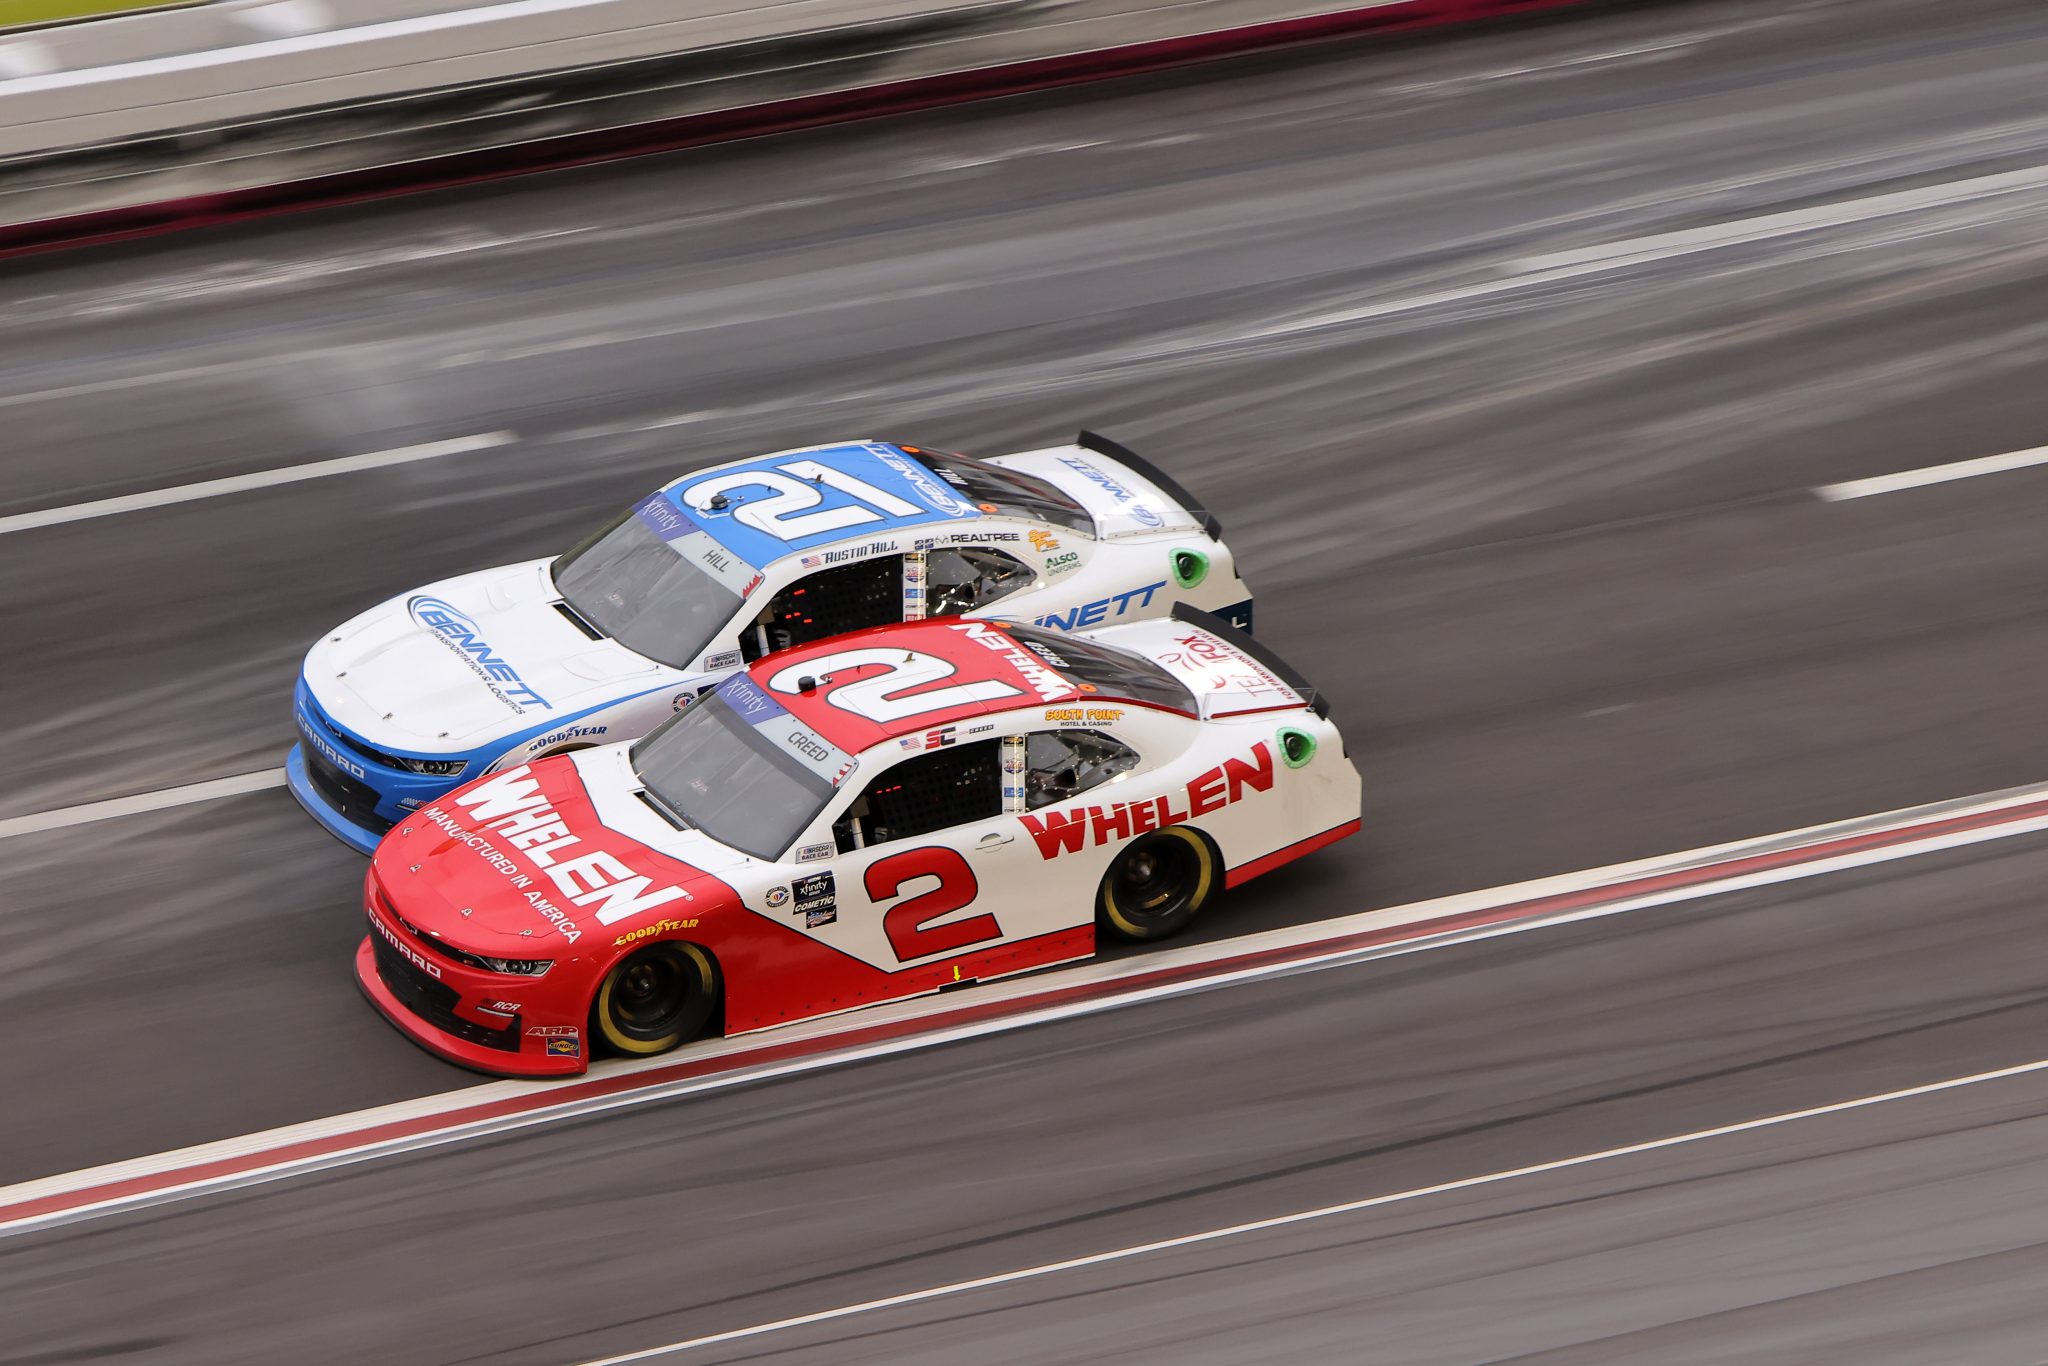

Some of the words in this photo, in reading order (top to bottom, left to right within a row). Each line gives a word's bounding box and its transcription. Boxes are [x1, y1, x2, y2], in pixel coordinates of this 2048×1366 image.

[933, 468, 968, 485] HILL
[682, 459, 929, 542] 21
[643, 499, 680, 533] xfinity
[951, 533, 1021, 543] REALTREE
[702, 549, 730, 573] HILL
[820, 545, 867, 564] AUSTIN
[869, 541, 898, 555] HILL
[1046, 552, 1078, 569] ALSCO
[417, 610, 553, 709] BENNETT
[710, 660, 724, 668] RACE
[944, 622, 1077, 702] WHELEN
[1024, 640, 1070, 668] CREED
[487, 682, 526, 715] LOGISTICS
[727, 679, 768, 716] xfinity
[767, 647, 1025, 724] 2
[1045, 709, 1083, 721] SOUTH
[1087, 709, 1125, 721] POINT
[298, 713, 365, 779] CAMARO
[526, 725, 608, 752] GOODYEAR
[787, 731, 829, 762] CREED
[925, 726, 956, 750] SC
[1017, 742, 1273, 861] WHELEN
[454, 764, 690, 927] WHELEN
[424, 807, 518, 876] MANUFACTURED
[510, 873, 534, 889] IN
[523, 891, 583, 945] AMERICA
[800, 880, 828, 896] xfinity
[795, 896, 834, 913] COMETIC
[863, 846, 1004, 963] 2
[368, 907, 441, 978] CAMARO
[612, 919, 699, 946] GOODYEAR
[493, 1001, 521, 1011] RCR
[526, 1026, 579, 1037] ARP
[549, 1042, 579, 1050] SUNOCO
